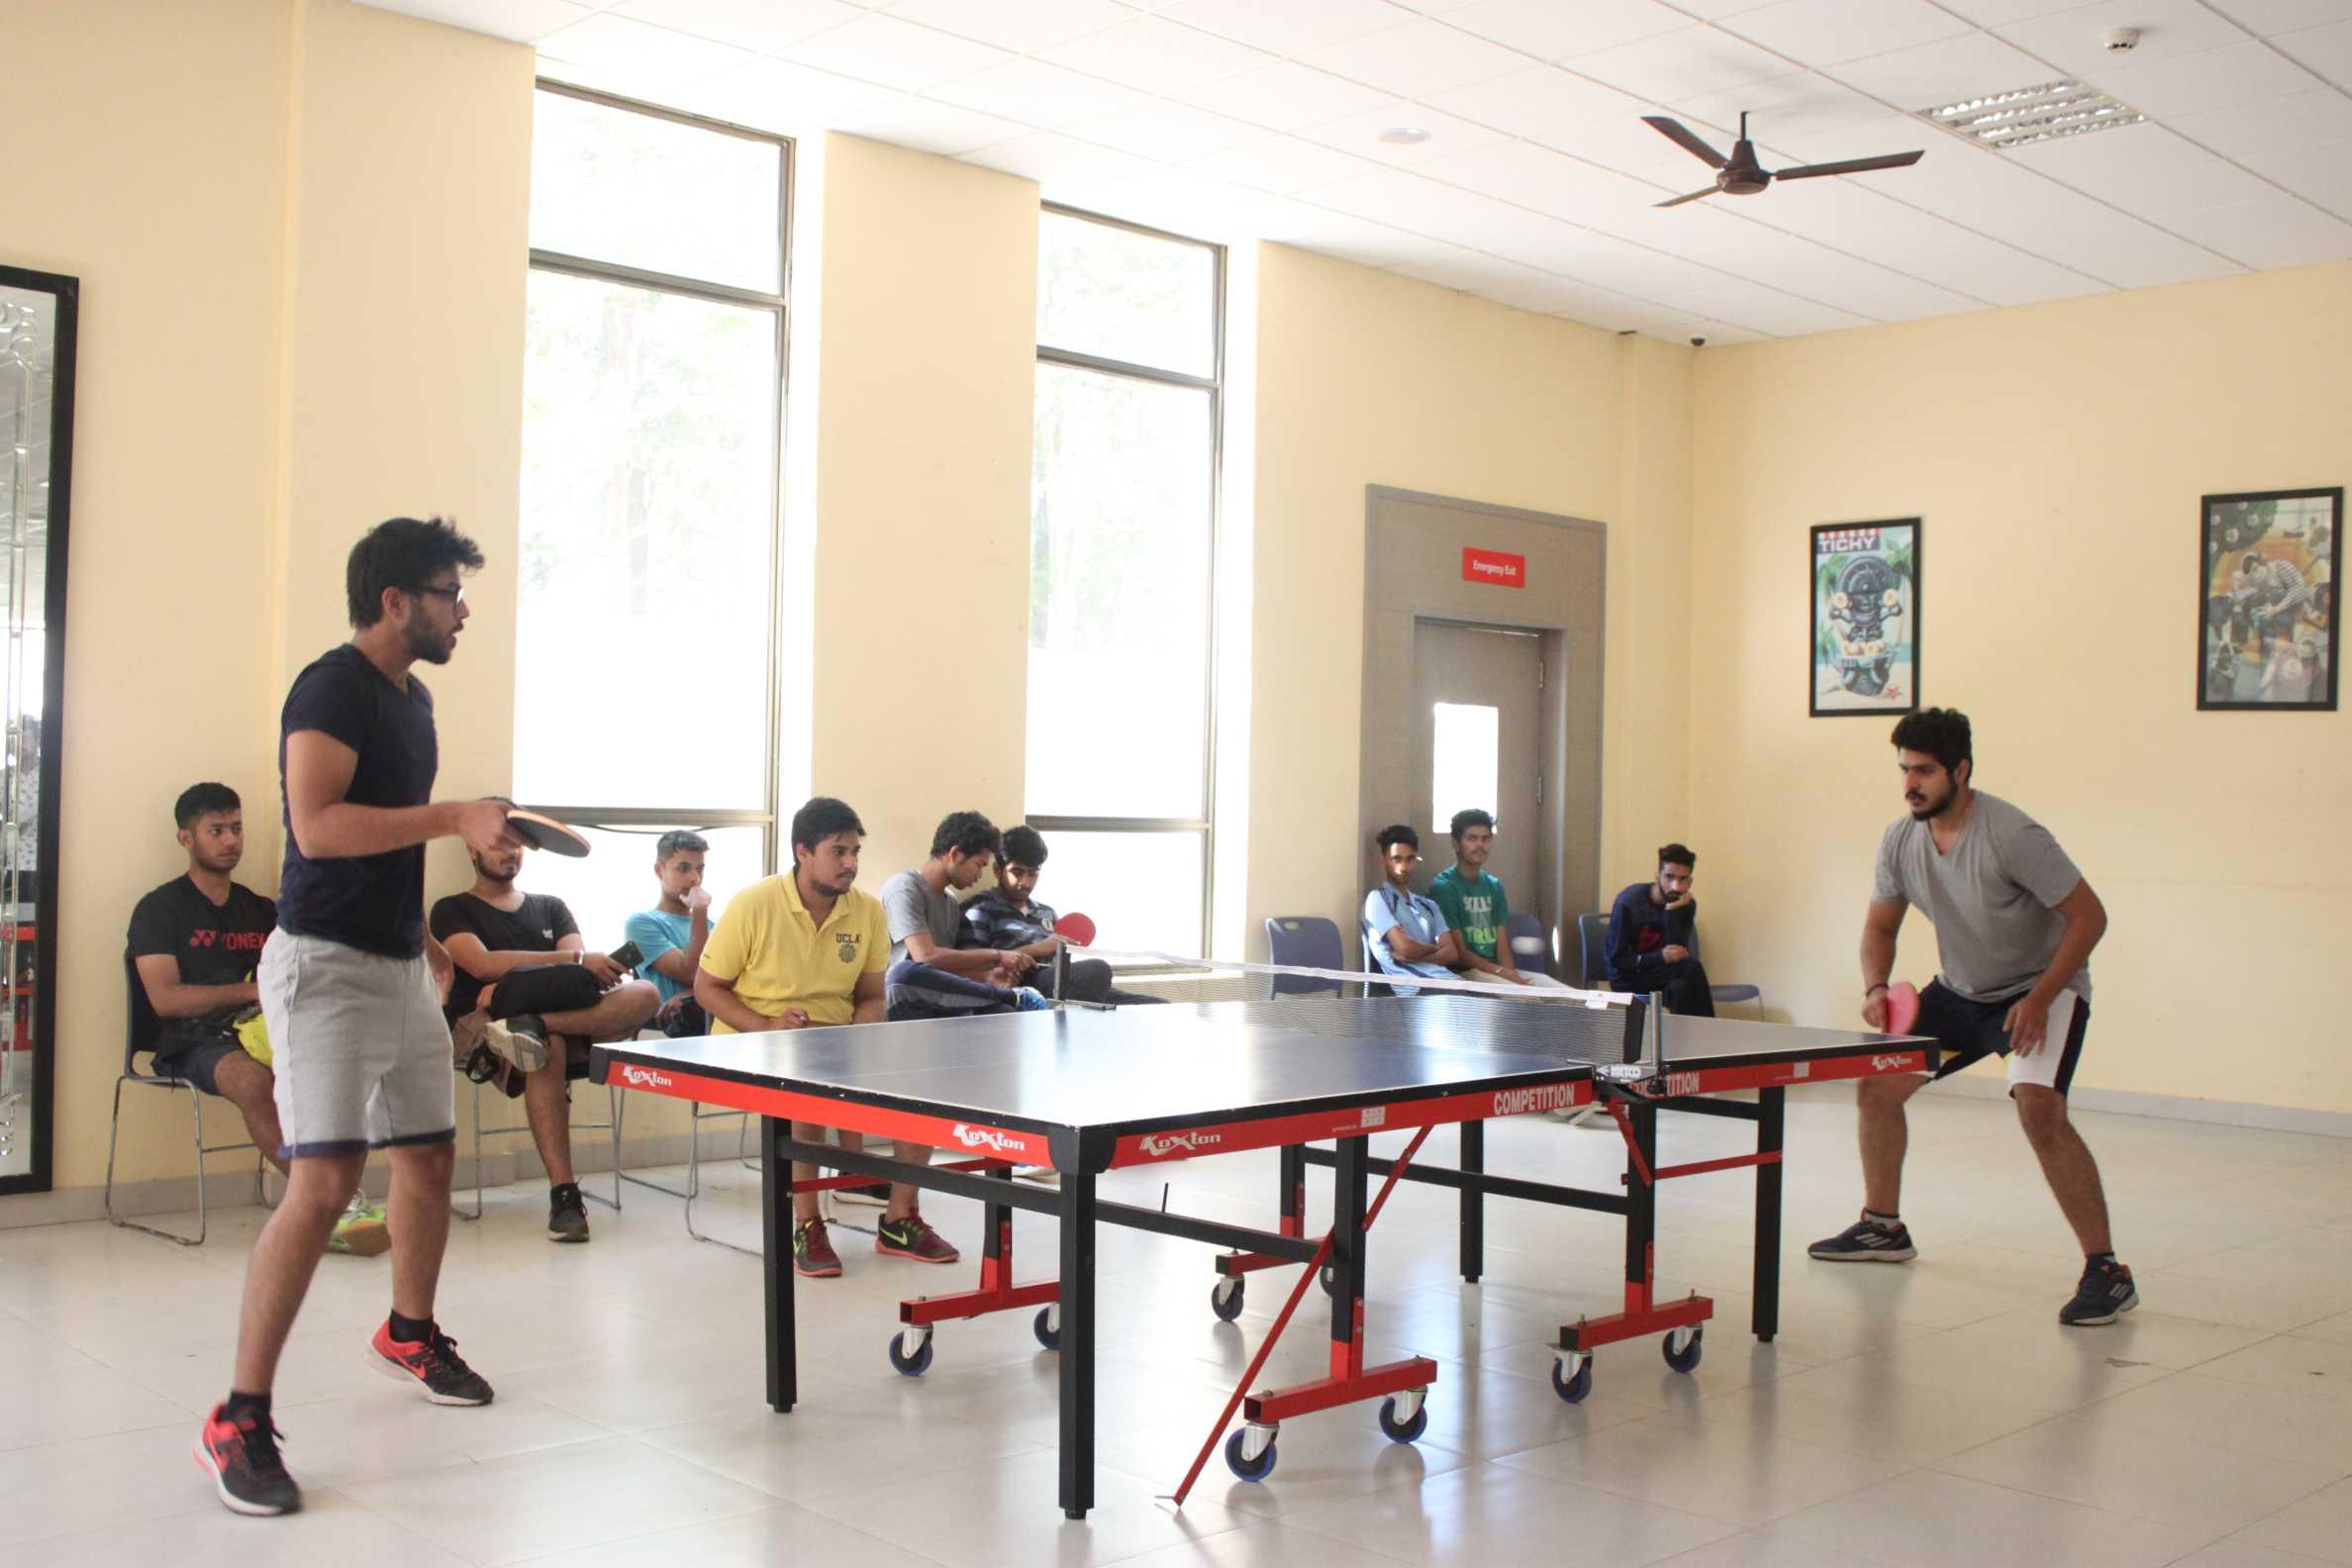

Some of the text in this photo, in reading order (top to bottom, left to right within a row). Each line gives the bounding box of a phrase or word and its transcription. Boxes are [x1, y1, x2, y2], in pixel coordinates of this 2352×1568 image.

[1473, 559, 1516, 576] Emergency Exit
[835, 933, 860, 943] UCLA
[1494, 1085, 1575, 1116] COMPETITION
